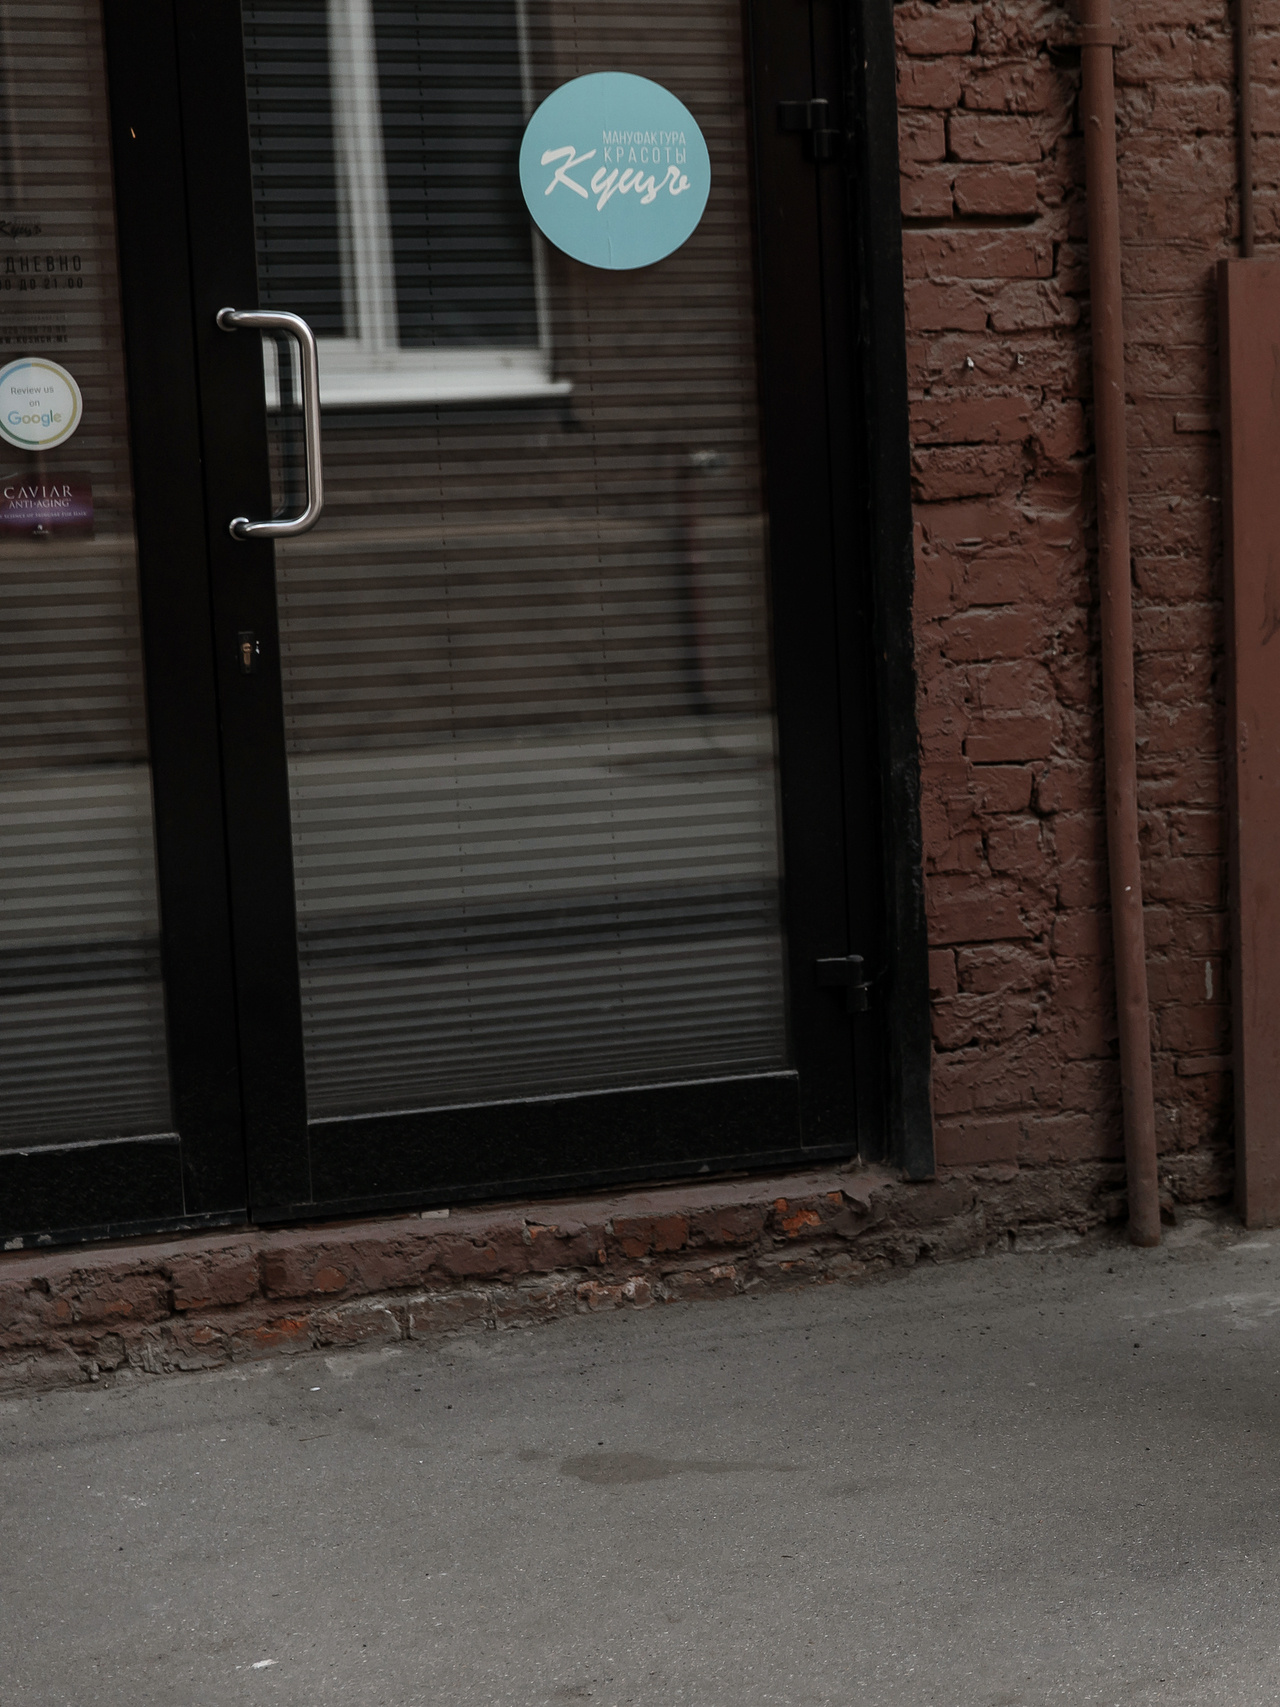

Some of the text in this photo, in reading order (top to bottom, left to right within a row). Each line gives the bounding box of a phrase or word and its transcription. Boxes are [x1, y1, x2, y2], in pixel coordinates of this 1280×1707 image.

[602, 129, 687, 145] МАНУФАКТУРА
[603, 146, 687, 164] КРАСОТЫ
[10, 386, 55, 395] Review us
[7, 409, 62, 427] Google
[3, 484, 73, 500] CAVIAR
